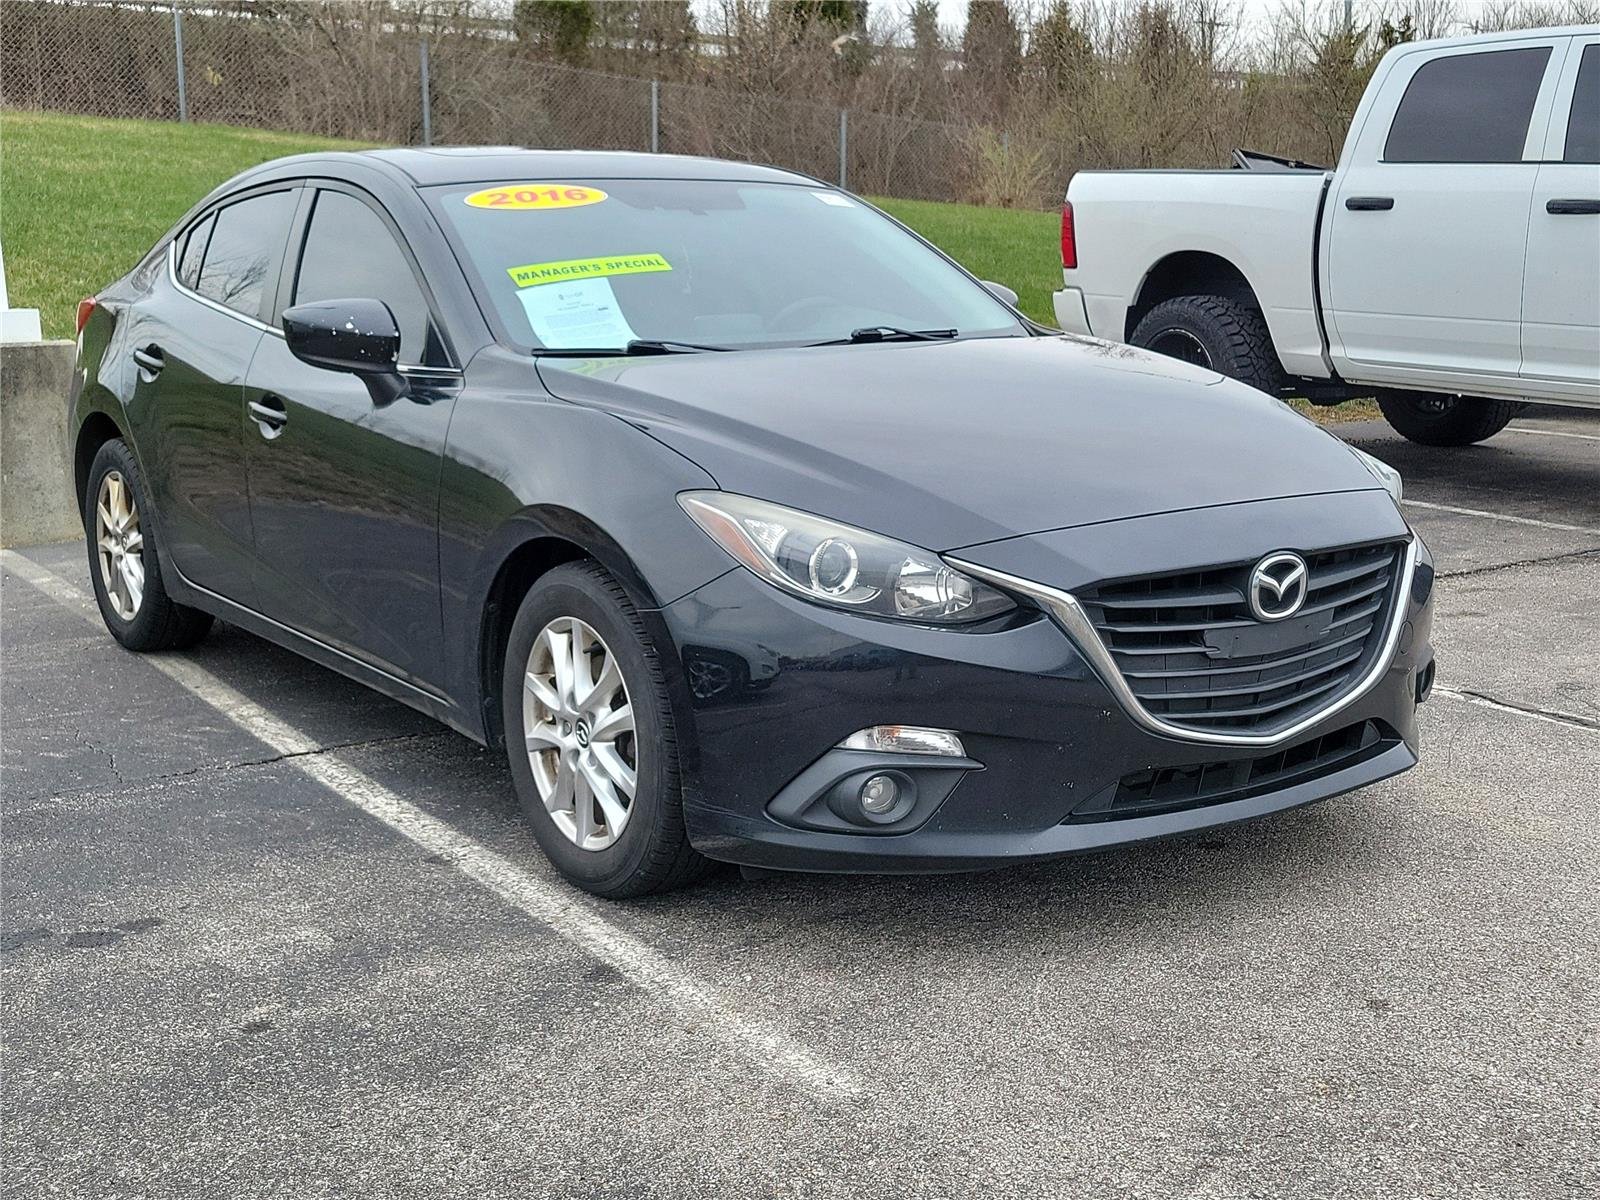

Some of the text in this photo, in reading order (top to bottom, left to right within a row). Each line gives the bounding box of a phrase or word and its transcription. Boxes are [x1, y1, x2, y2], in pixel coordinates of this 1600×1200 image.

[488, 188, 588, 206] 2016
[517, 258, 665, 281] MANAGER'S SPECIAL
